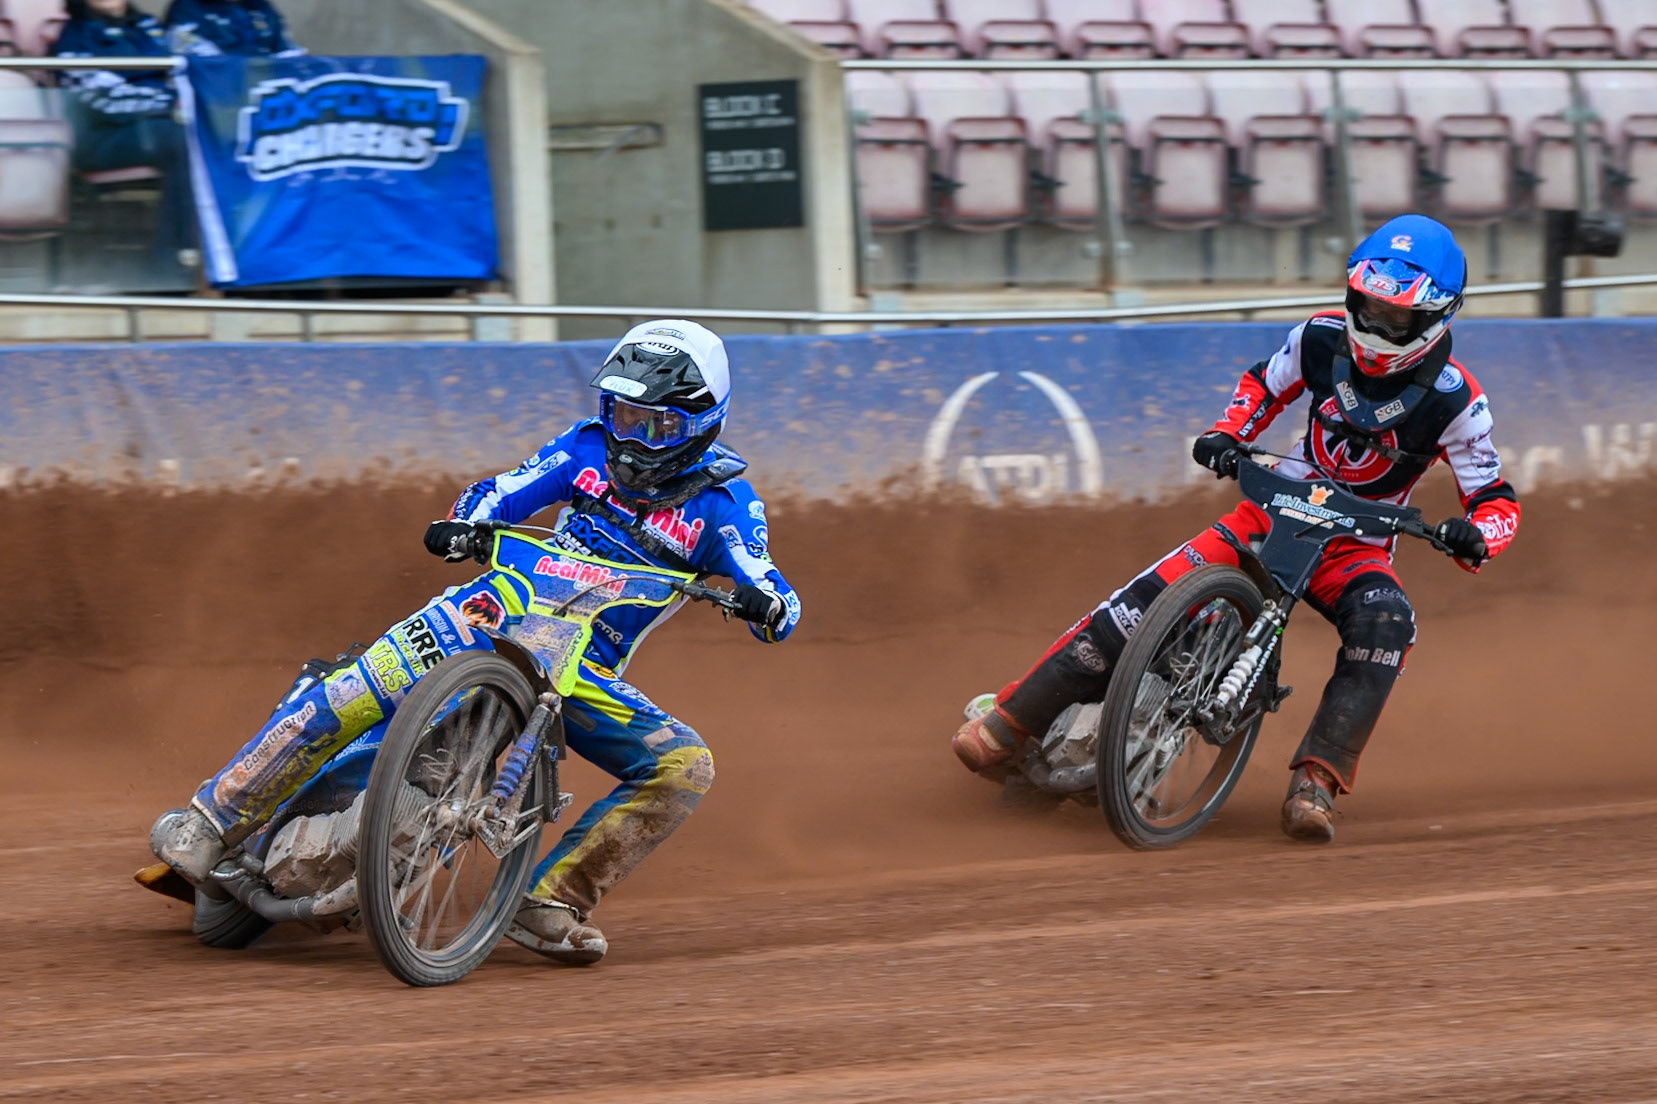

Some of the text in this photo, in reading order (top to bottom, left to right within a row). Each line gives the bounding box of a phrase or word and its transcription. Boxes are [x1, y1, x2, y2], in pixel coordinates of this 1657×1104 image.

[704, 95, 761, 118] BLOCK
[706, 149, 763, 172] BLOCK
[1384, 401, 1402, 415] GB
[534, 556, 581, 581] Real
[578, 564, 627, 593] Mini
[1371, 647, 1401, 667] Bell
[244, 704, 315, 772] Construction
